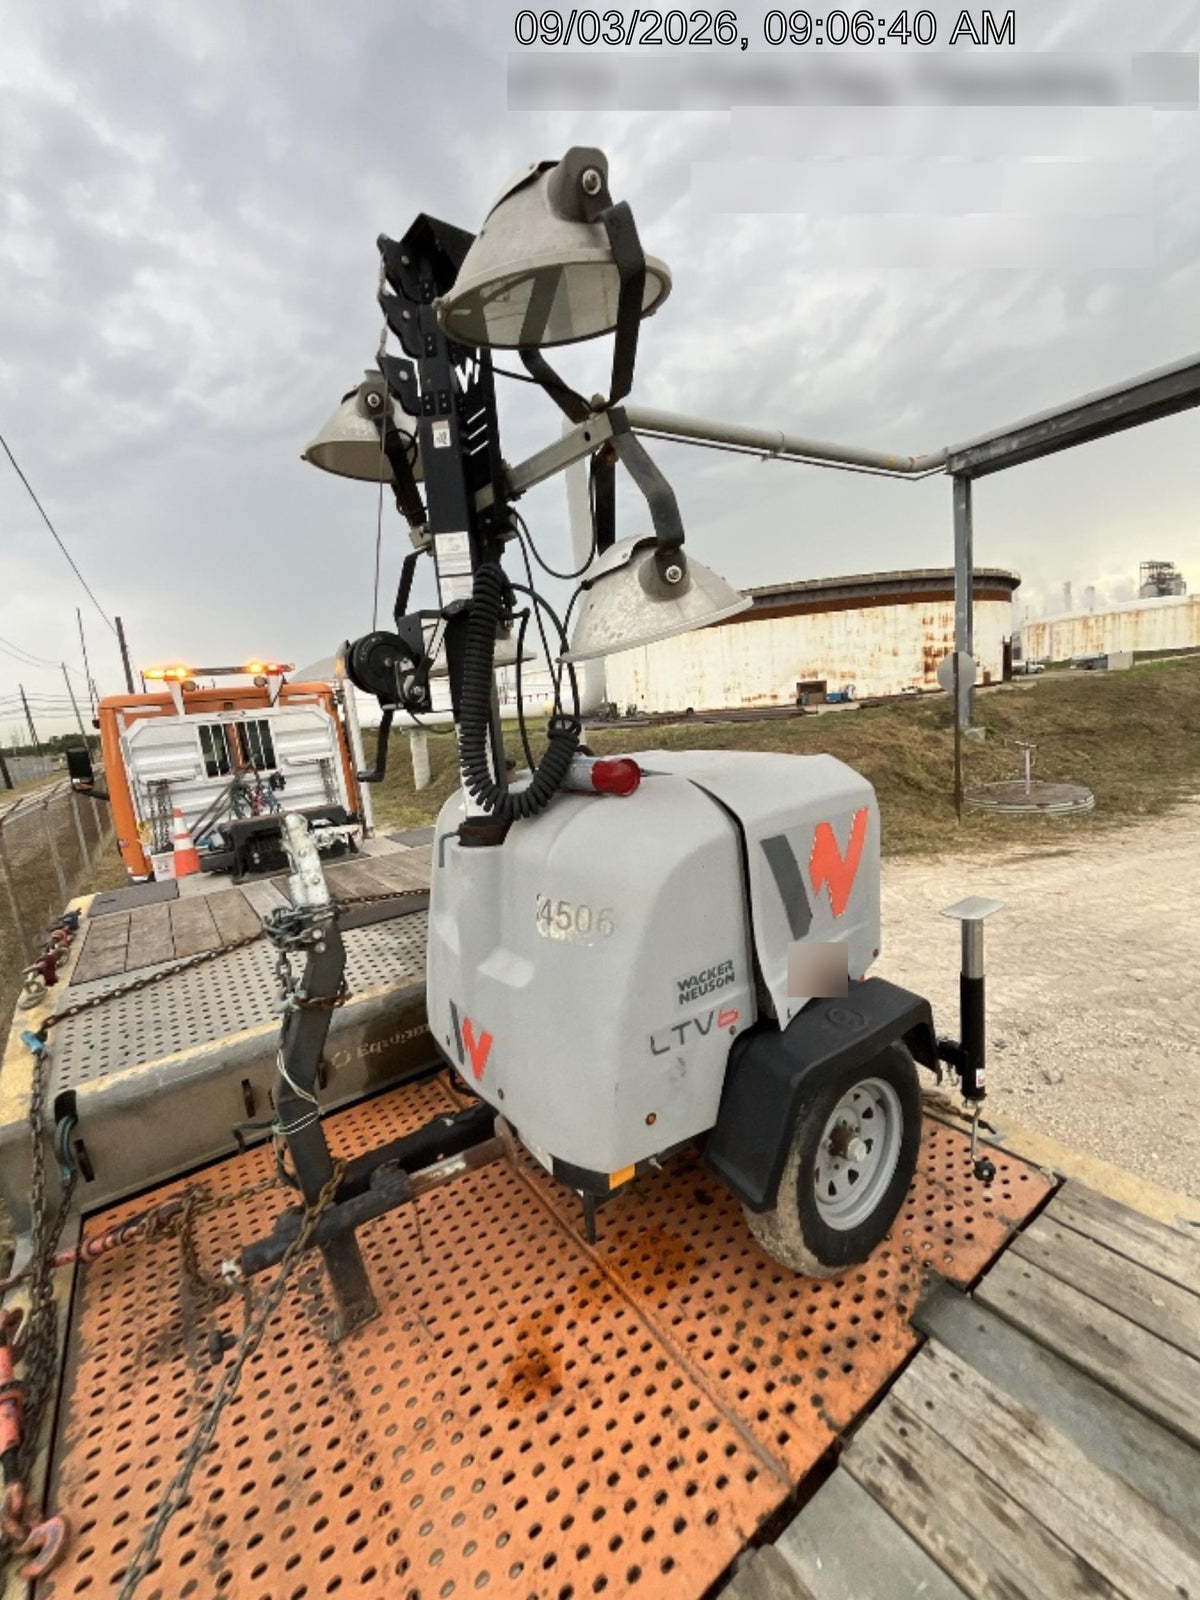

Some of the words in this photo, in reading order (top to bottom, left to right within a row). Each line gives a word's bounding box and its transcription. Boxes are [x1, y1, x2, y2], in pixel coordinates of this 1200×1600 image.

[540, 898, 616, 938] 4506
[677, 959, 734, 991] WACKER
[678, 972, 736, 1005] NEUSON
[650, 1007, 740, 1056] LTV6
